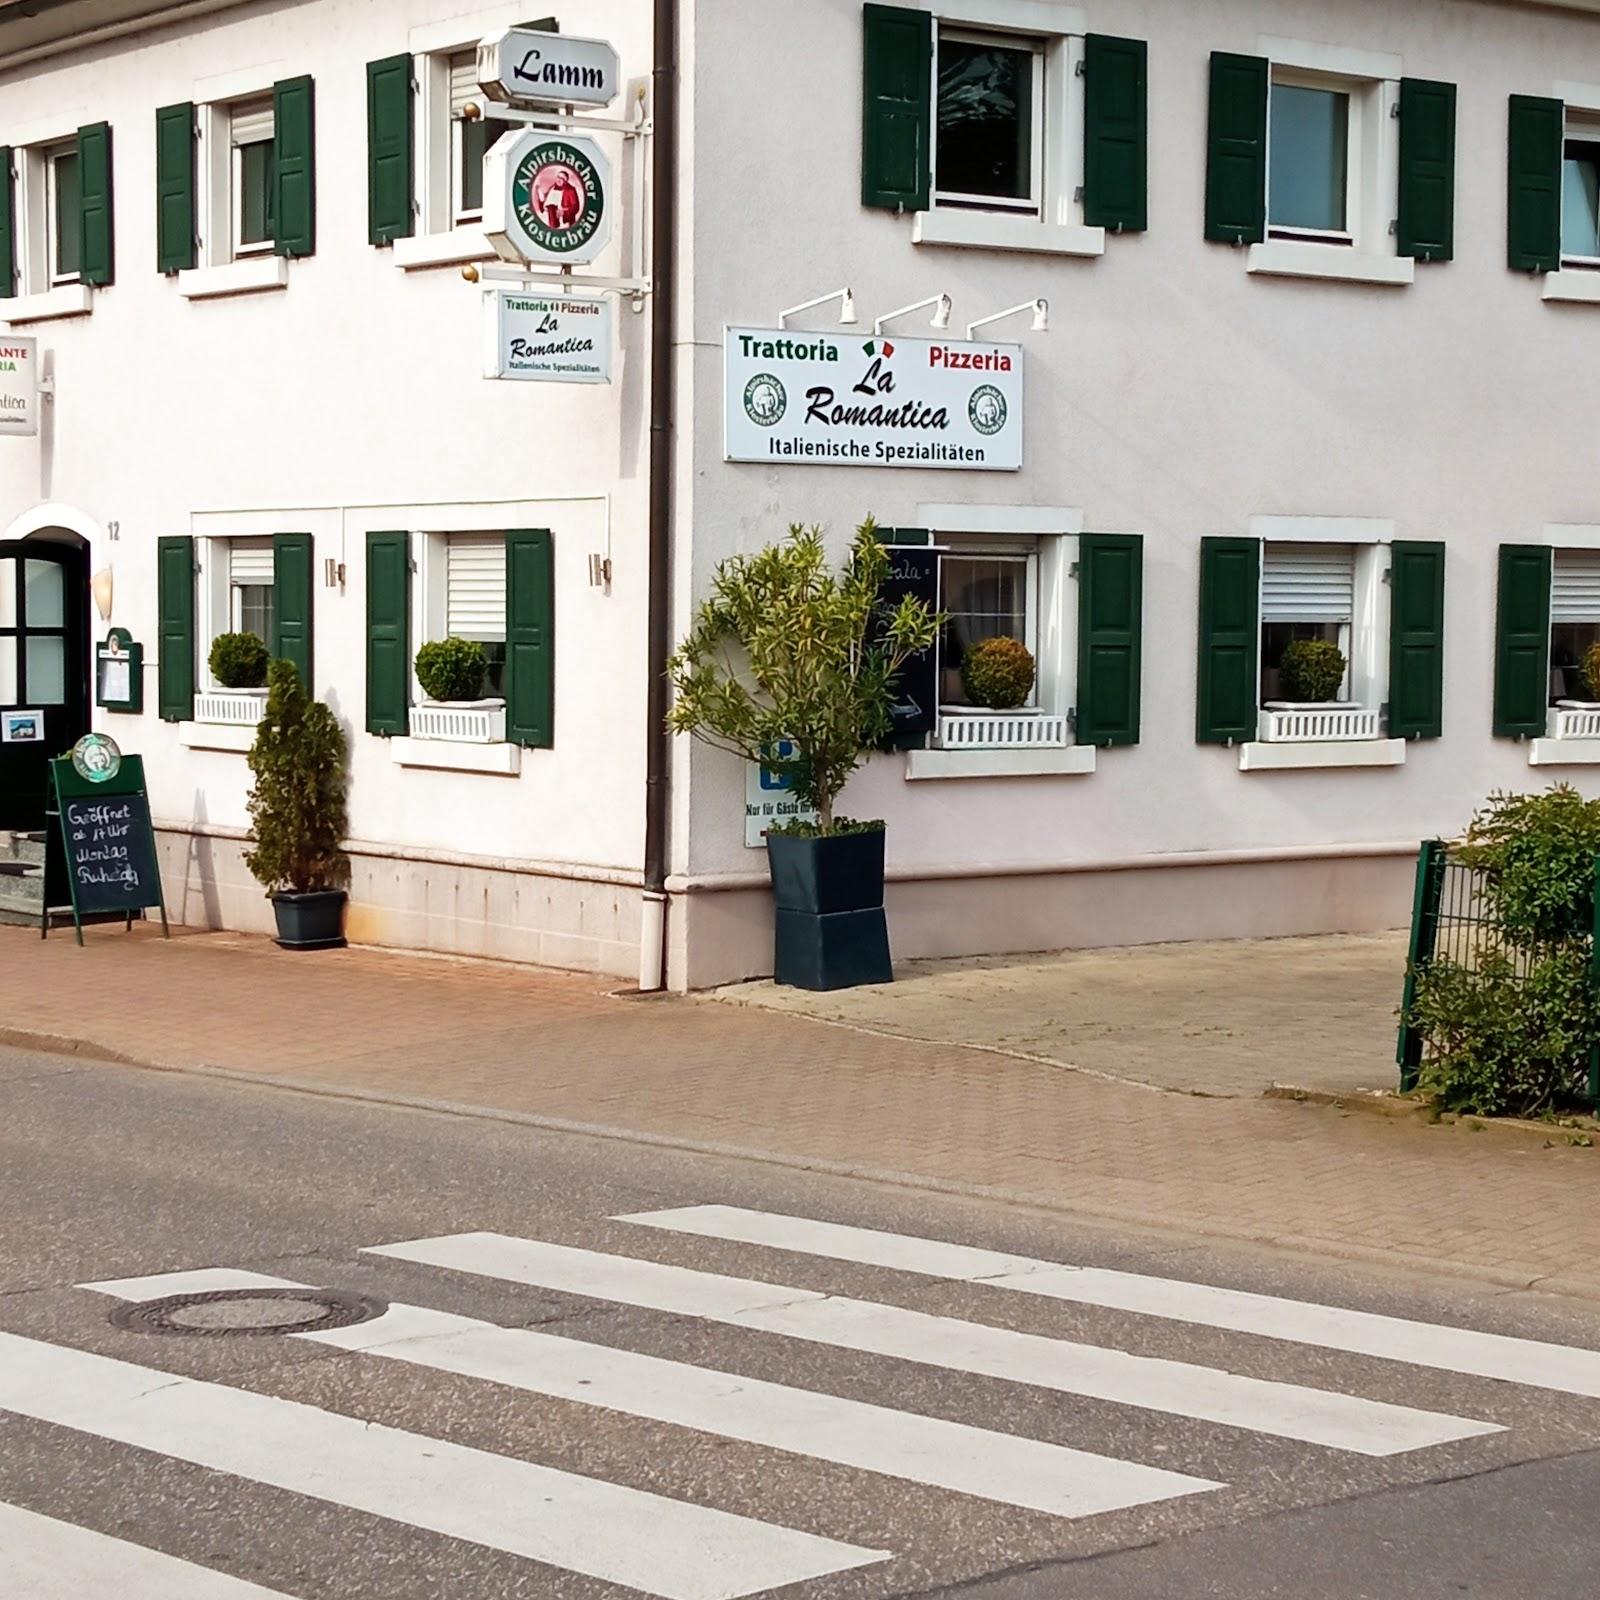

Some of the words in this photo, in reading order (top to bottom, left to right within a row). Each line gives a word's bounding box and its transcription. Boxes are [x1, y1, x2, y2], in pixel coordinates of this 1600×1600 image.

[513, 49, 604, 89] Lamm
[517, 146, 597, 200] Alpirsbacher
[518, 203, 598, 248] Klosterbräu
[506, 299, 548, 312] Trattoria
[561, 302, 600, 315] Pizzeria
[535, 313, 559, 334] La
[510, 337, 594, 359] Romantica
[738, 335, 839, 362] Trattoria
[929, 346, 1012, 372] Pizzeria
[508, 361, 552, 371] Italienische
[552, 363, 600, 373] Spezialitäten
[852, 357, 896, 397] La
[804, 386, 950, 430] Romantica
[769, 437, 870, 458] Italienische
[875, 440, 986, 463] Spezialitäten
[107, 520, 120, 541] 12
[67, 804, 131, 826] Geöffnet
[746, 804, 760, 816] Nur
[763, 803, 774, 816] für
[776, 802, 799, 815] Gäste
